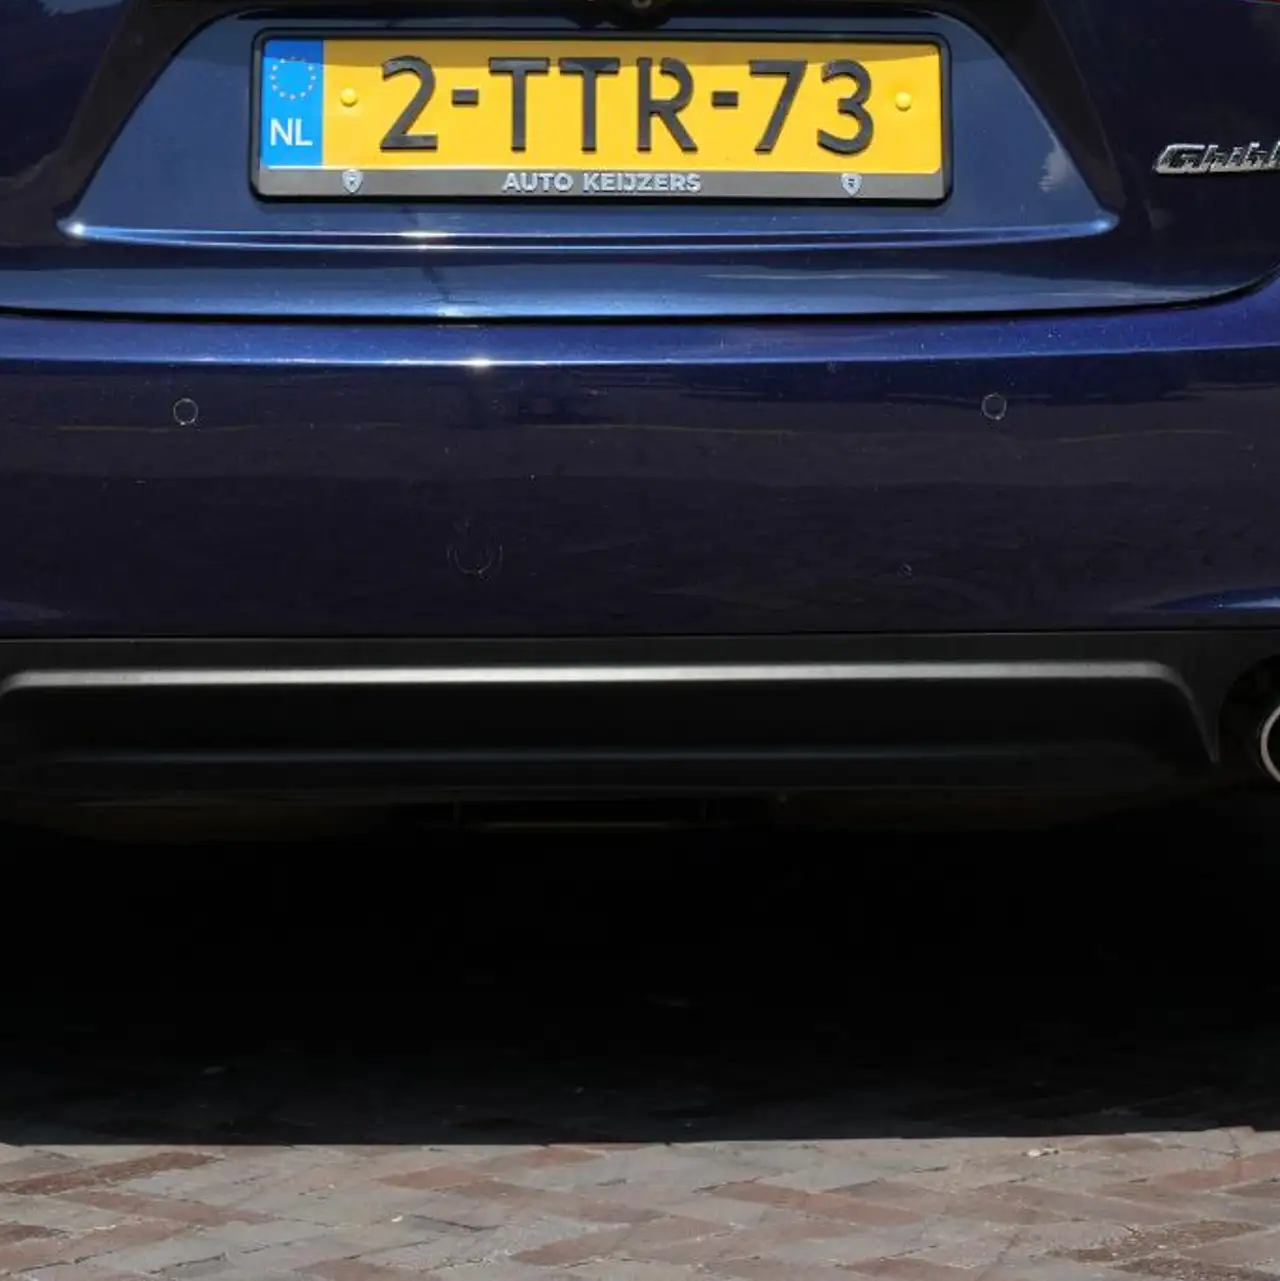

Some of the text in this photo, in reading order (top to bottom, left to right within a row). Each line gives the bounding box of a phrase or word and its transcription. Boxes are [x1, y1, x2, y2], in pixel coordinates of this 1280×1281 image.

[379, 56, 875, 155] 2-TTR-73
[270, 118, 313, 147] NL
[502, 171, 701, 194] AUTO KEIJZERS
